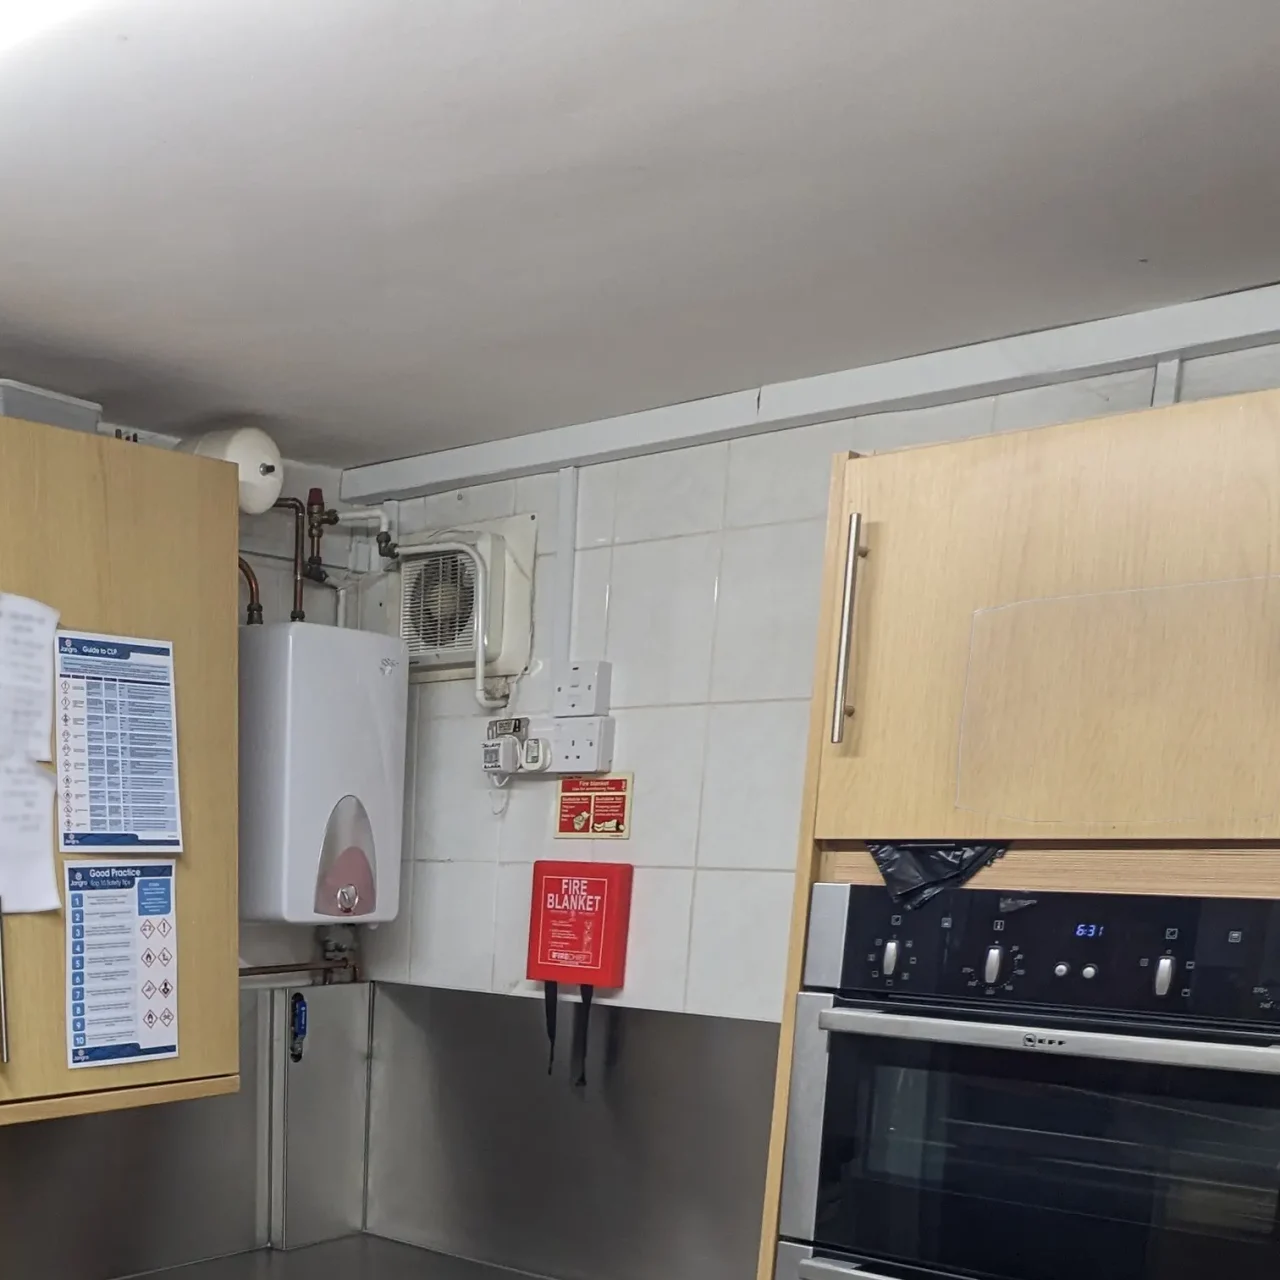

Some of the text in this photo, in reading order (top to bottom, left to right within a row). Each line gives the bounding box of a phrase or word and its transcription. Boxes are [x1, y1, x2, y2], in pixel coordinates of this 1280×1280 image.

[83, 646, 99, 655] Guide
[89, 867, 141, 878] Good Practice
[562, 879, 588, 896] FIRE
[546, 893, 602, 912] BLANKET
[1076, 924, 1104, 937] 6:31
[76, 1036, 84, 1045] 10
